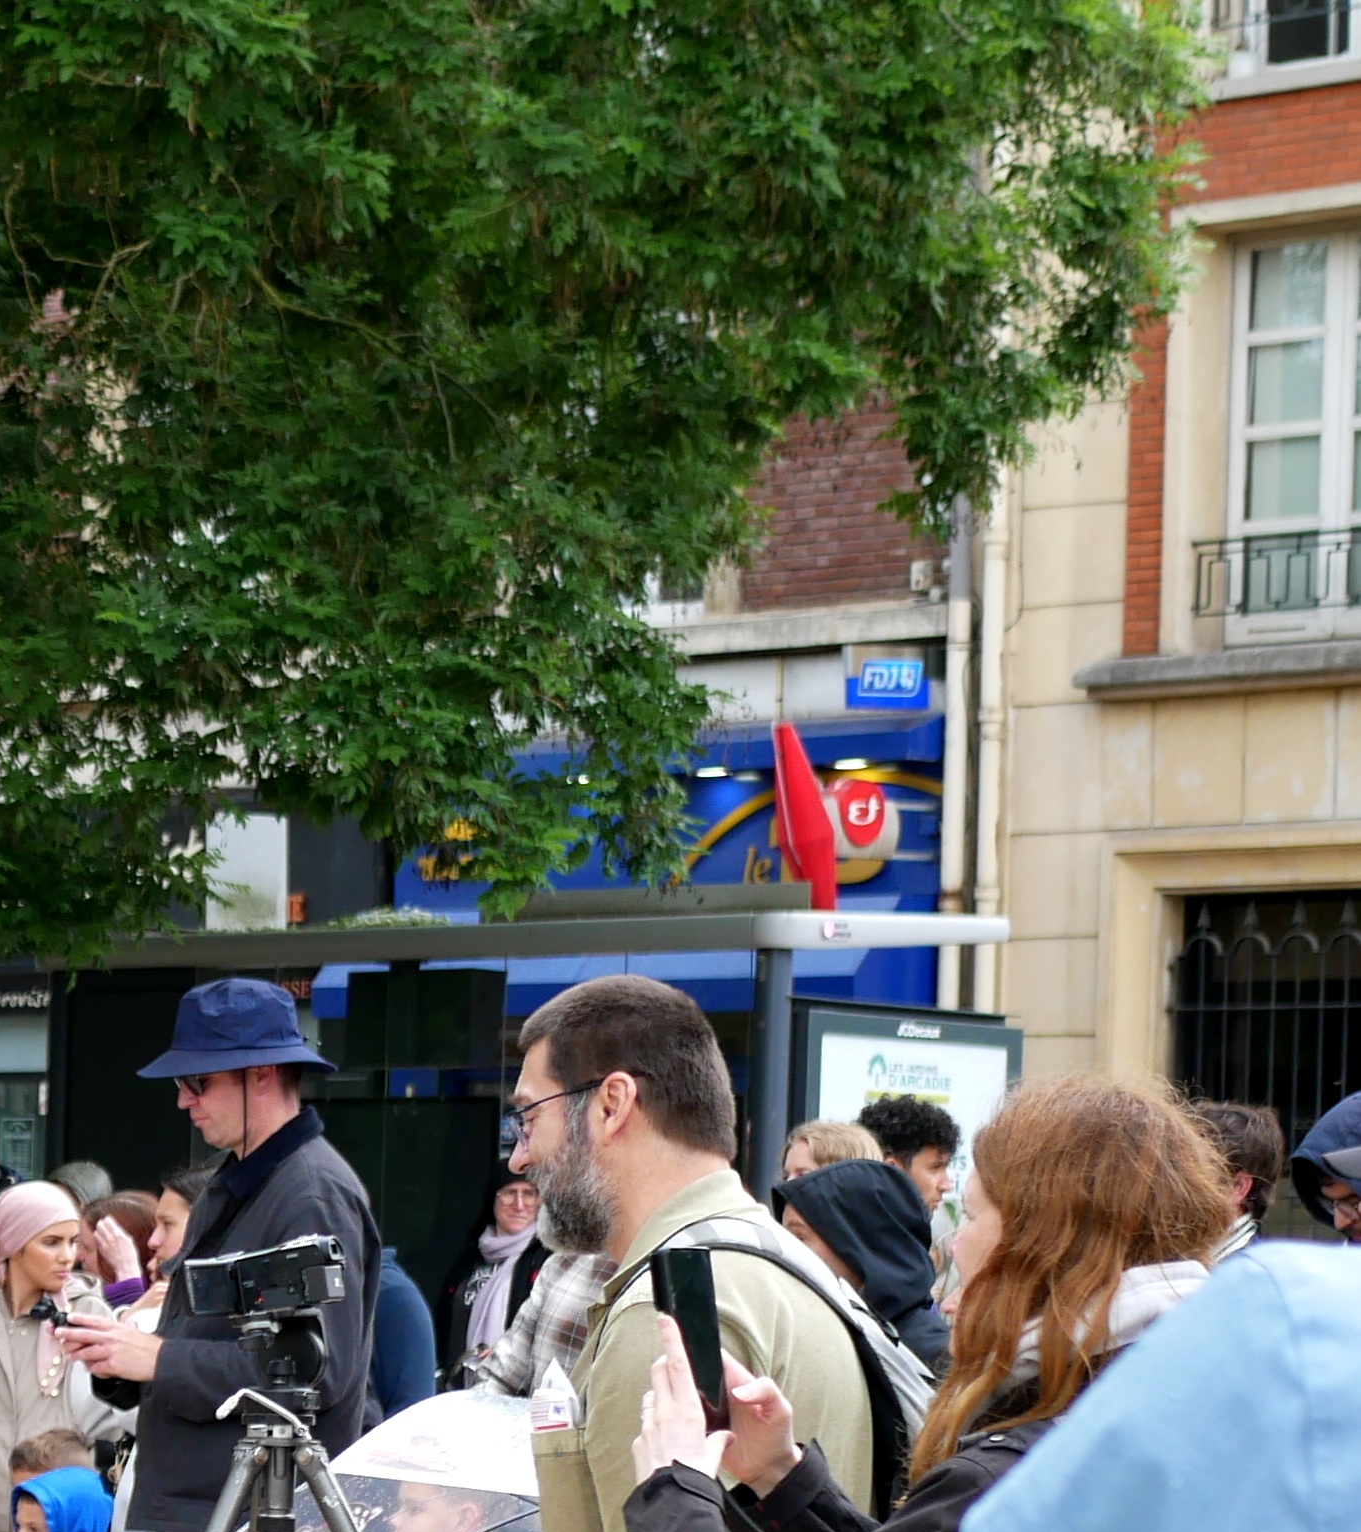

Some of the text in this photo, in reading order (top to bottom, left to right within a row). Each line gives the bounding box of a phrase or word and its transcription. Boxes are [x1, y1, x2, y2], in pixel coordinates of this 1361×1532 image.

[863, 666, 899, 690] FDJ
[897, 1020, 941, 1039] JCDecaux
[889, 1063, 938, 1076] LES JARDINS
[888, 1074, 952, 1092] D'ARCADIE
